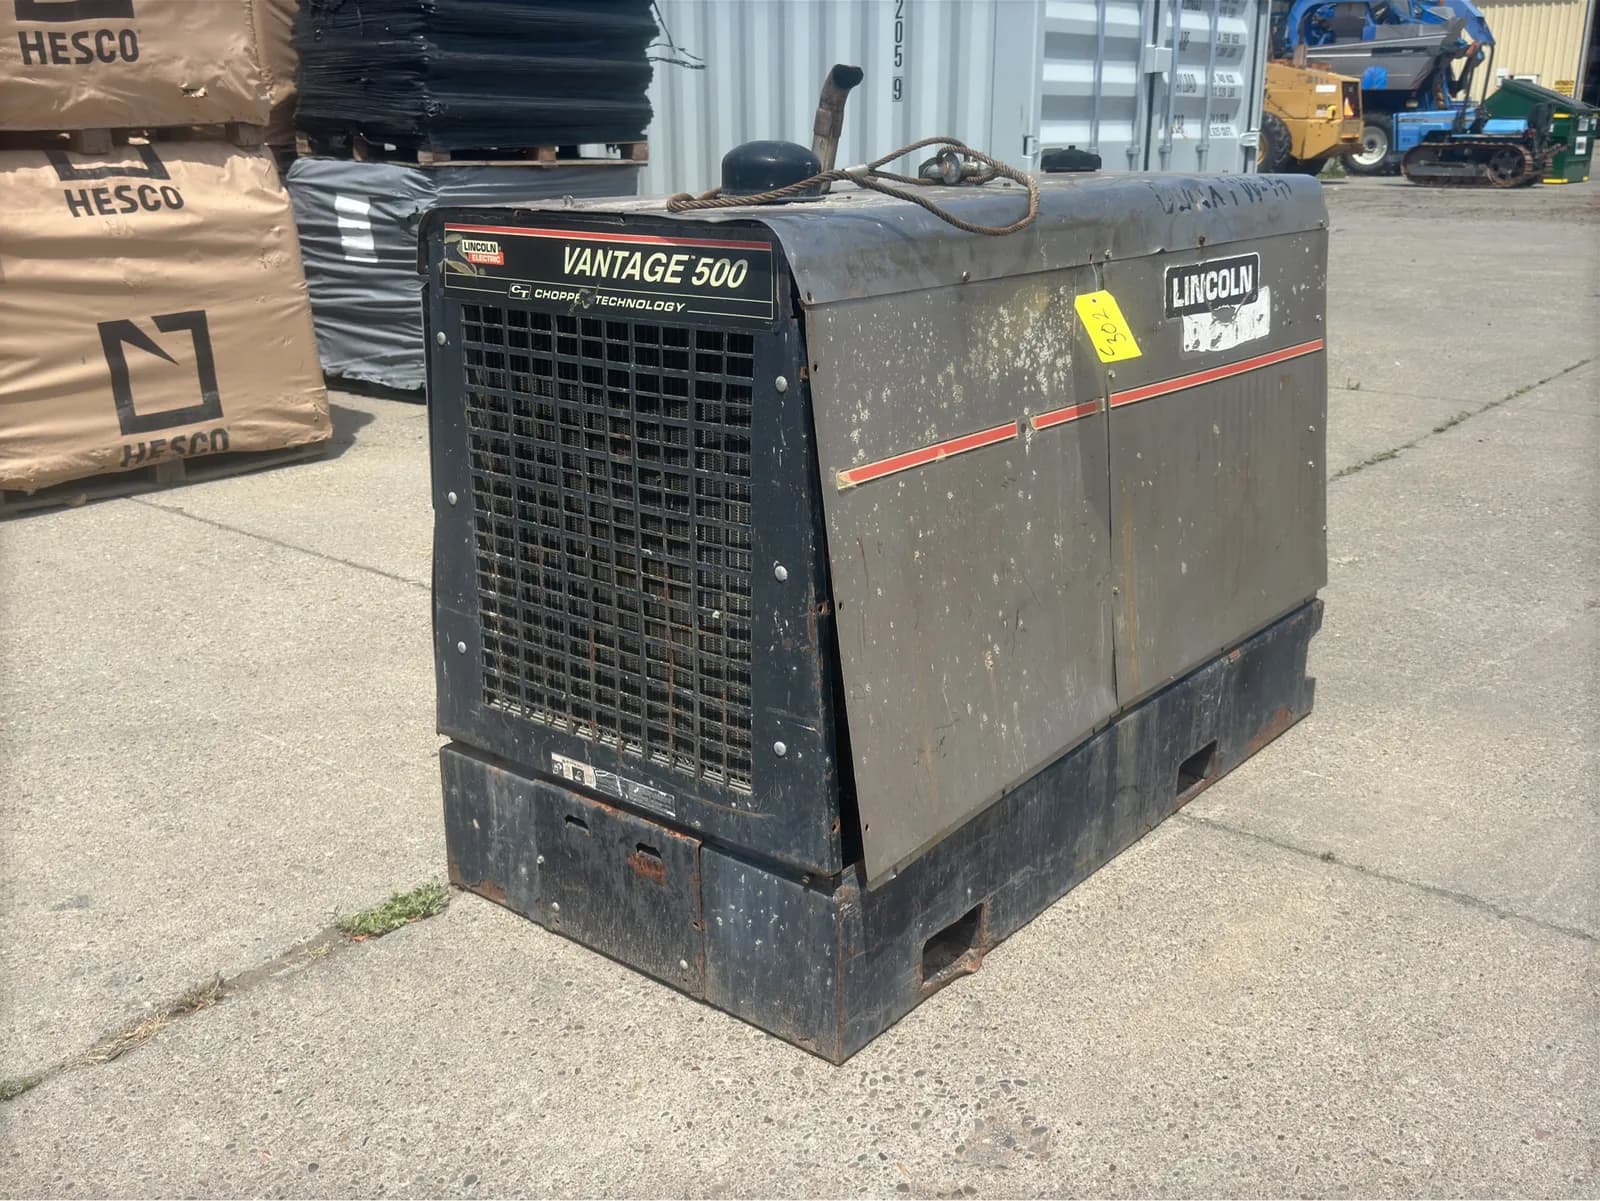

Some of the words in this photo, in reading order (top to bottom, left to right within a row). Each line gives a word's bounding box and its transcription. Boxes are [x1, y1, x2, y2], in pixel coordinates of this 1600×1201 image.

[18, 28, 140, 65] HESCO
[63, 184, 185, 218] HESCO
[463, 241, 497, 253] LINCOLN
[563, 246, 688, 284] VANTAGE
[692, 257, 748, 289] 500
[1172, 264, 1253, 308] LINCOLN
[595, 295, 686, 314] TECHNOLOGY
